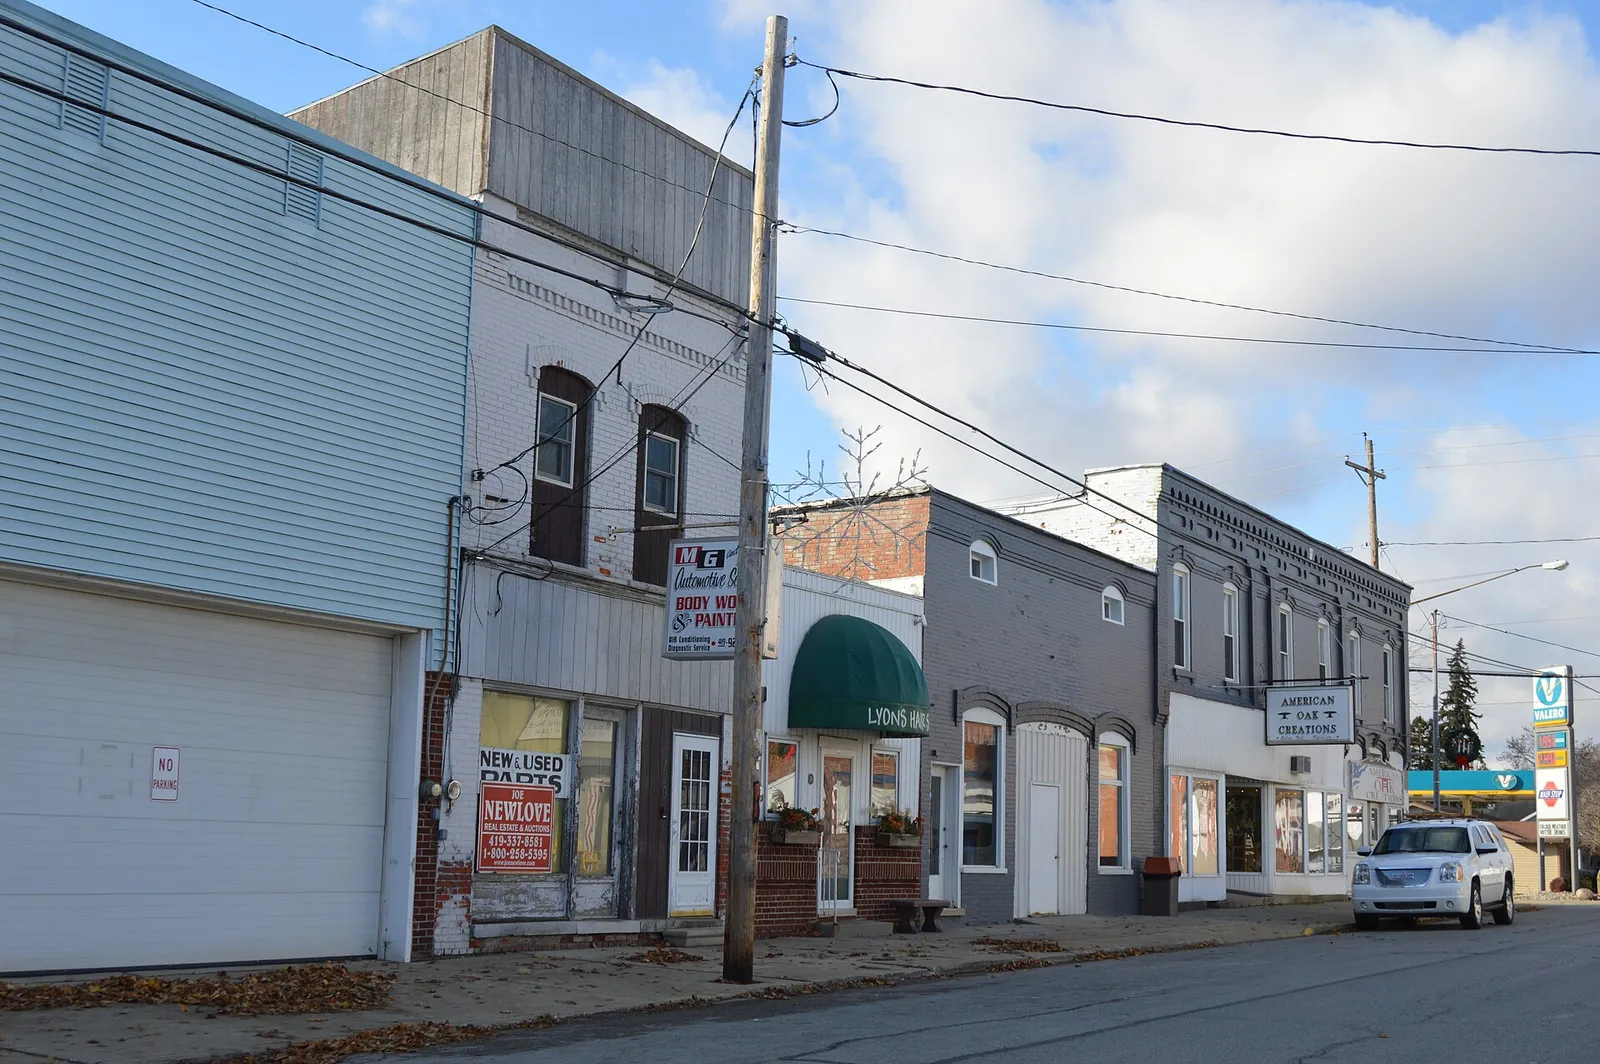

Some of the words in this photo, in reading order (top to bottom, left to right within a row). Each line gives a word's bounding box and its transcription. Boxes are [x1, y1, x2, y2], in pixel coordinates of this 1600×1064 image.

[680, 547, 698, 563] M
[703, 551, 718, 567] G
[674, 567, 726, 591] Automotive
[676, 596, 710, 611] BODY
[673, 613, 692, 631] &
[679, 636, 711, 645] Conditioning
[668, 645, 692, 653] Diagnostic
[693, 645, 711, 653] Service
[1281, 696, 1335, 707] AMERICAN
[868, 707, 907, 728] LYONS
[1297, 711, 1319, 720] OAK
[1534, 709, 1564, 721] VALERO
[1278, 725, 1337, 735] CREATIONS
[159, 758, 173, 771] NO
[481, 750, 514, 768] NEW
[514, 757, 521, 769] &
[523, 754, 563, 772] USED
[153, 779, 177, 790] PARKING
[511, 789, 525, 800] JOE
[484, 800, 550, 823] NEWLOVE
[484, 823, 498, 831] REAL
[499, 824, 518, 832] ESTATE
[525, 825, 550, 833] AUCTIONS
[489, 835, 543, 847] 419-337-8581
[483, 847, 548, 860] 1-800-258-5395
